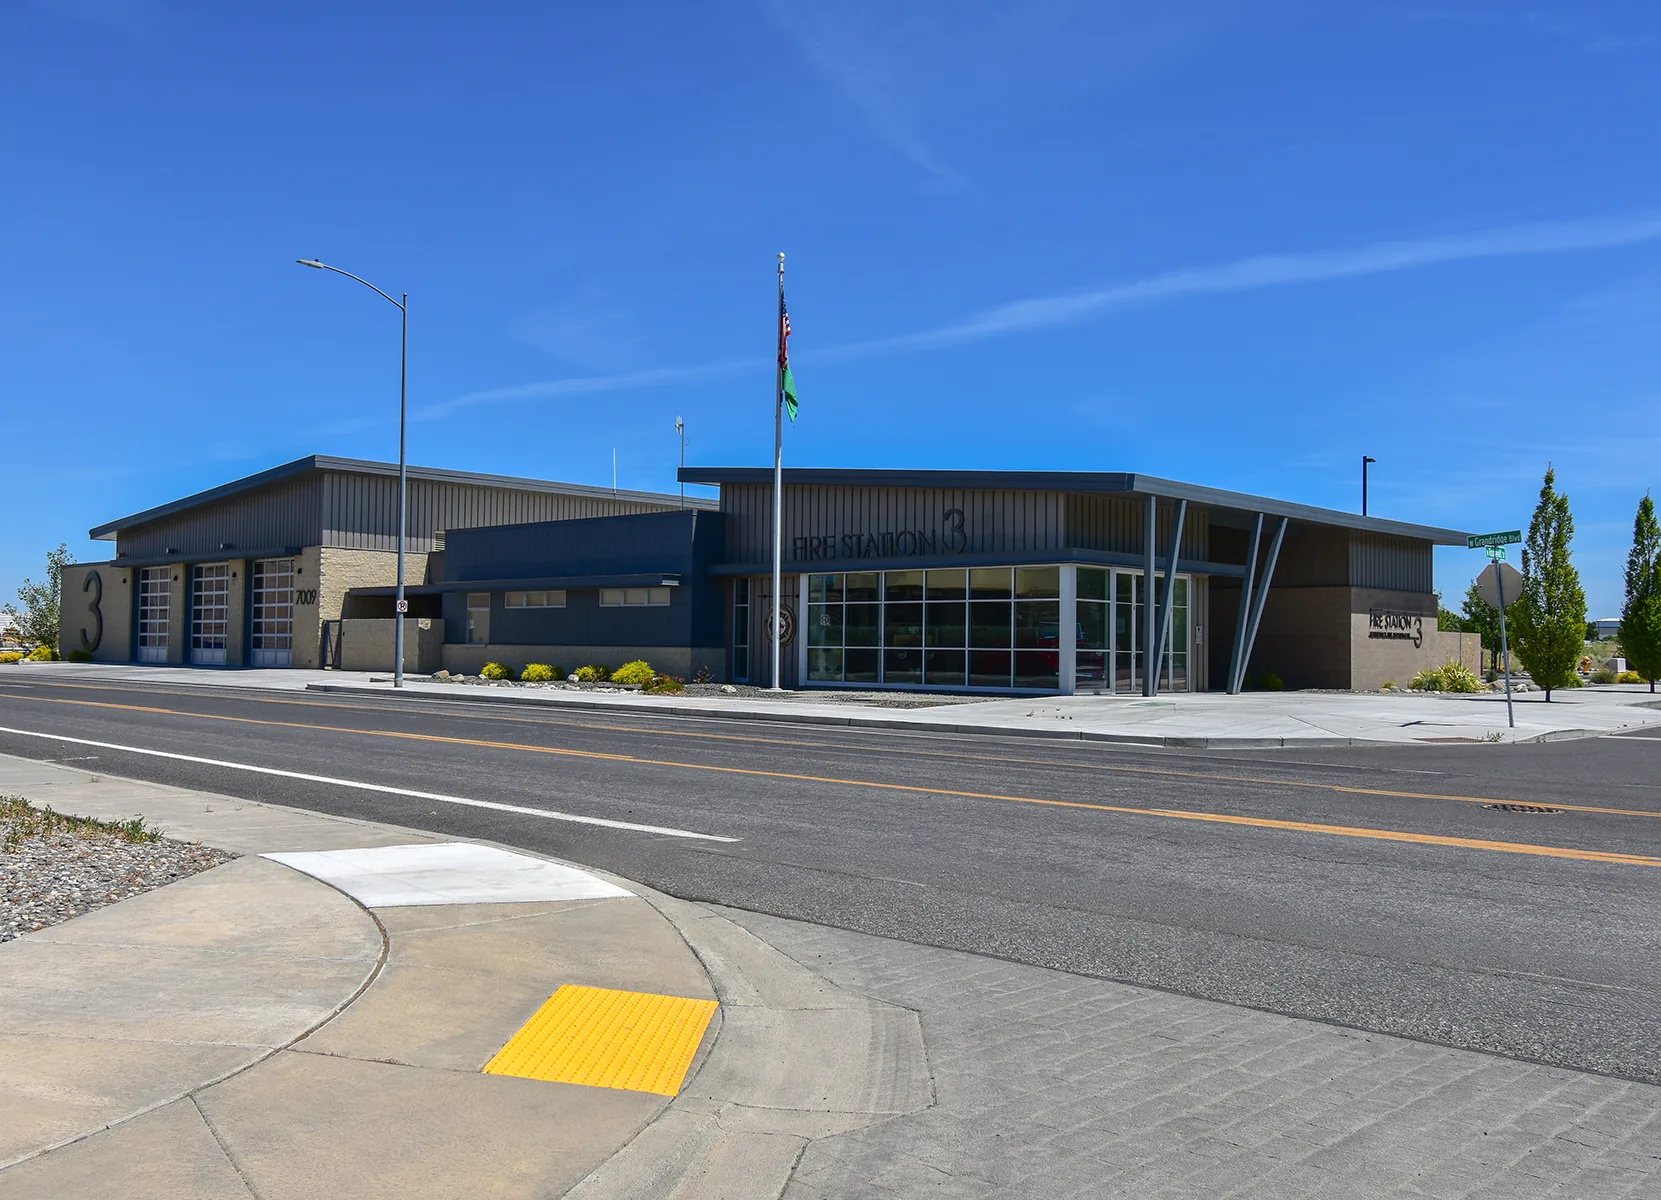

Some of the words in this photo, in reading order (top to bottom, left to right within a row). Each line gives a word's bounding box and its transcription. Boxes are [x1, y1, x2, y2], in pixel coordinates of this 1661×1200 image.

[793, 535, 835, 560] FIRE
[841, 529, 936, 558] STATION
[943, 508, 967, 553] 3
[1474, 534, 1508, 547] Grandridge
[1508, 534, 1521, 543] Blvd
[80, 569, 103, 652] 3
[296, 589, 317, 605] 7009
[1369, 613, 1383, 630] FIRE
[1384, 614, 1412, 631] STATION
[1413, 616, 1423, 649] 3
